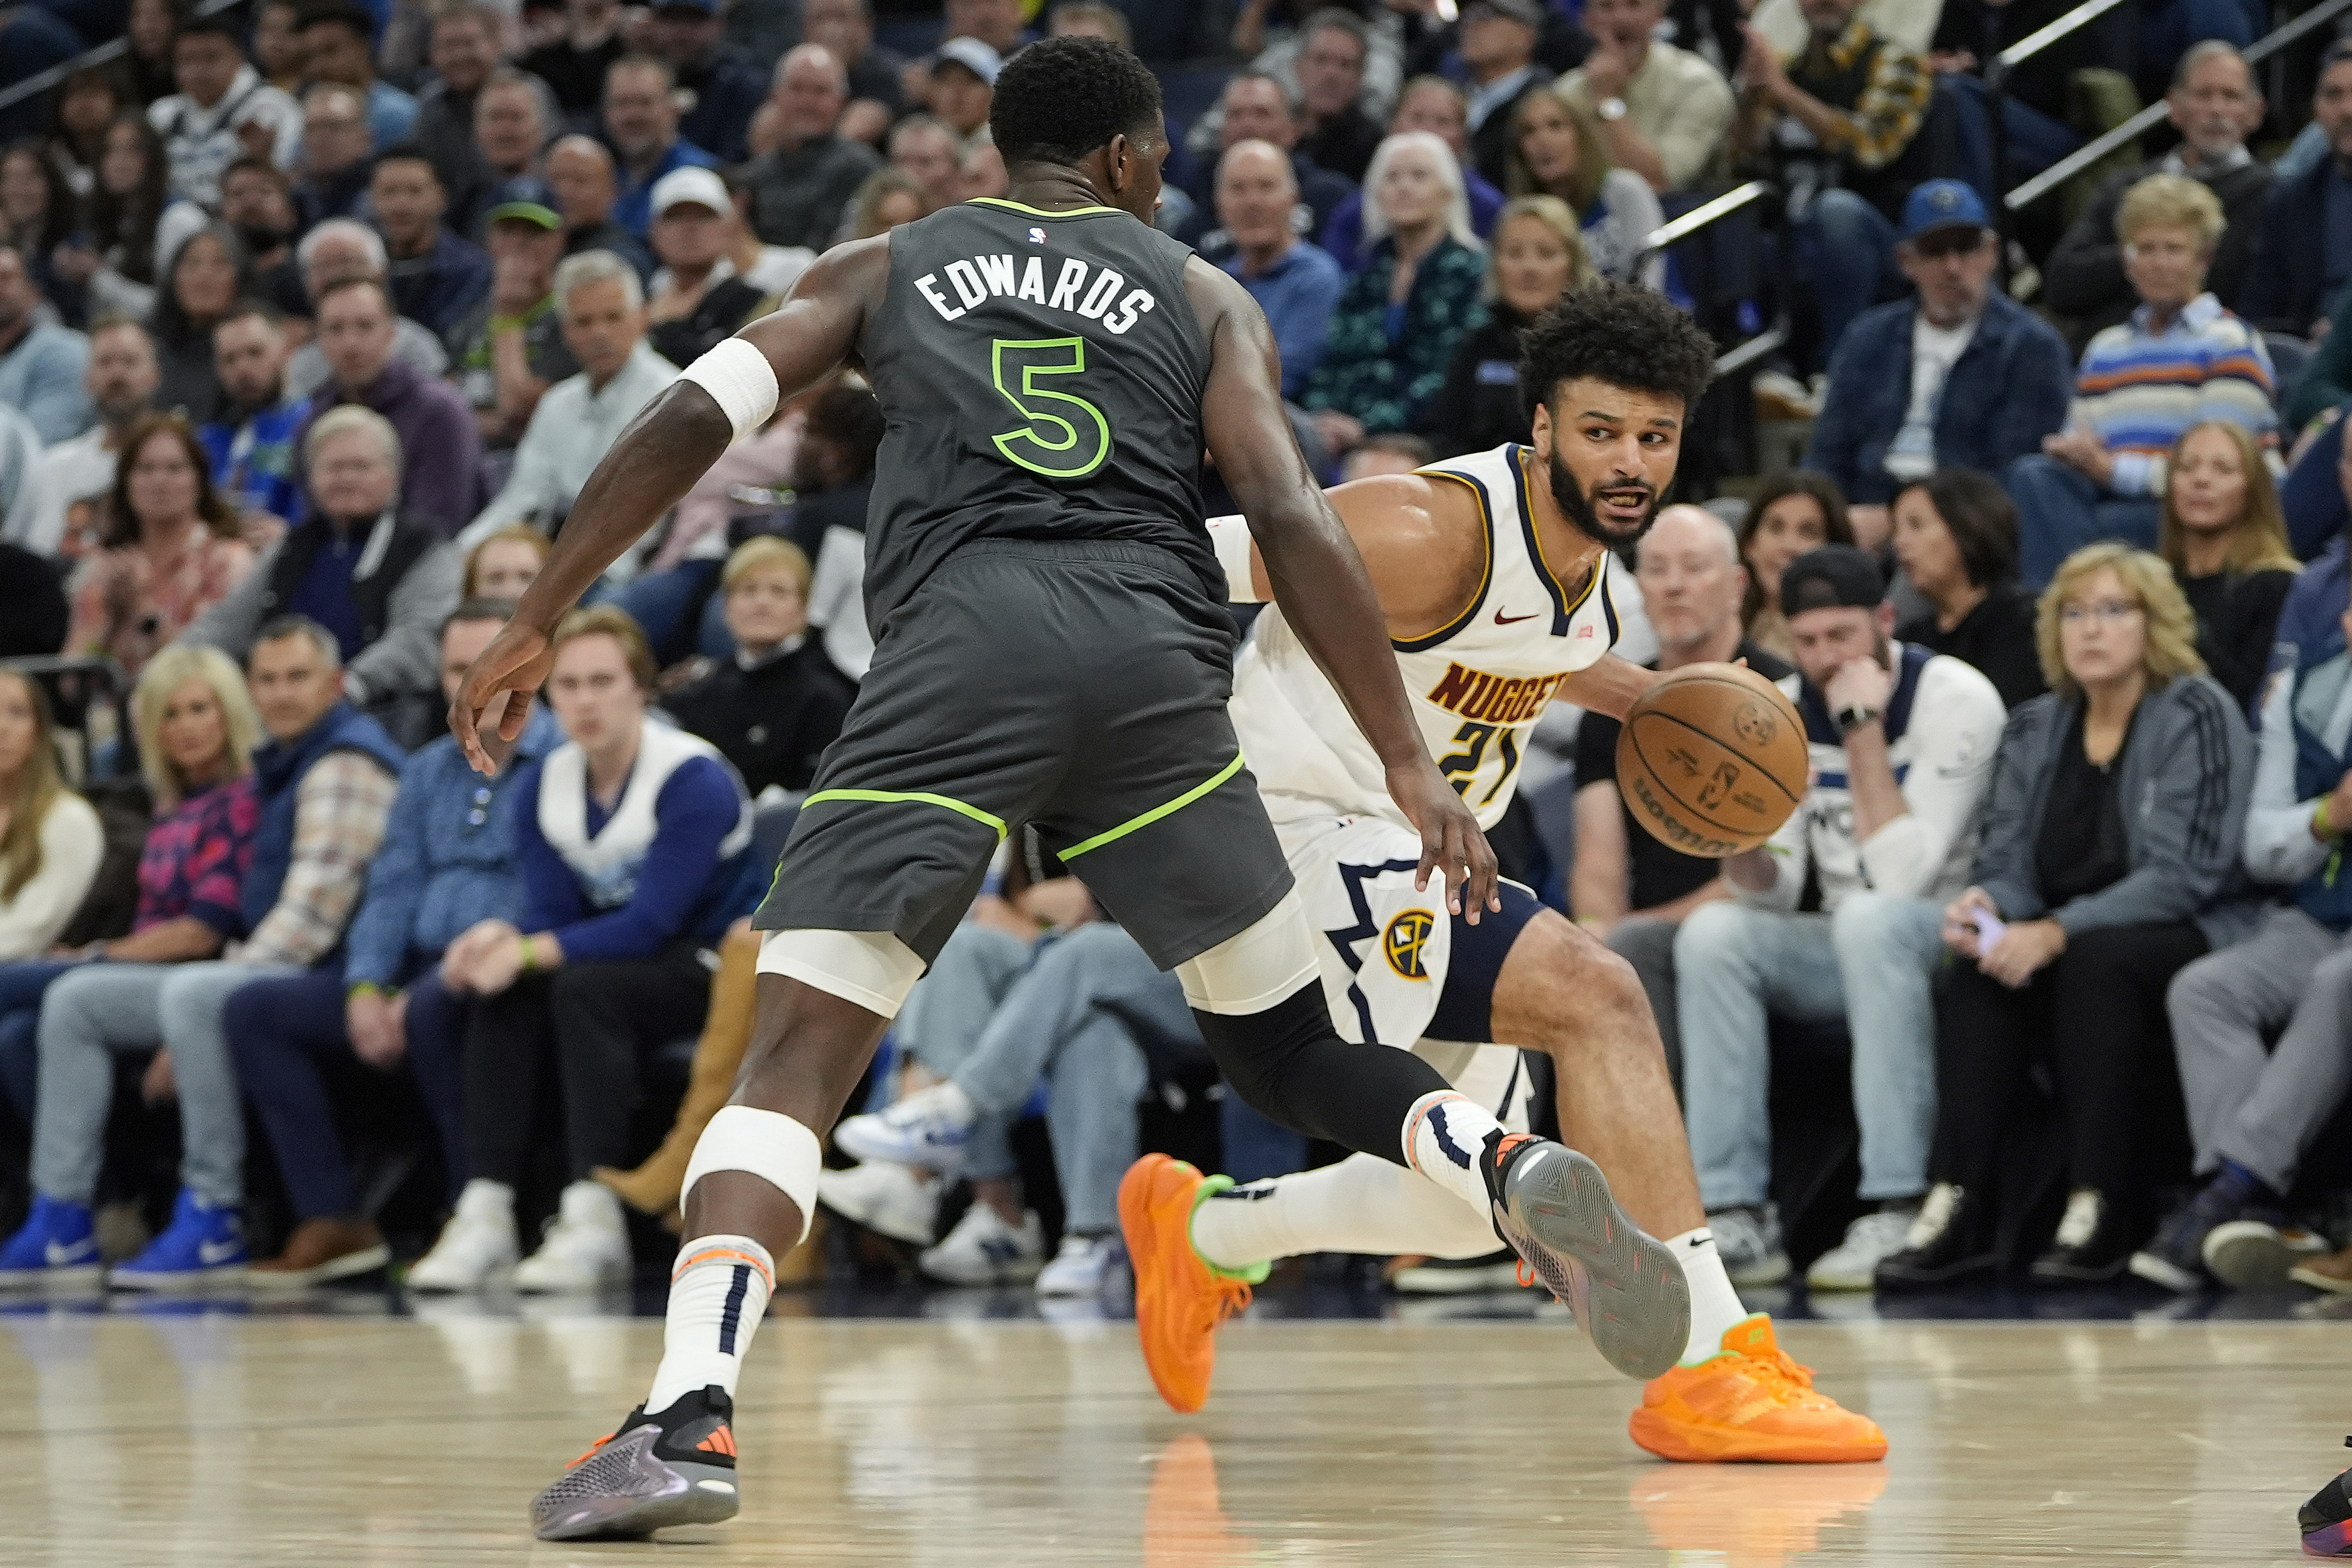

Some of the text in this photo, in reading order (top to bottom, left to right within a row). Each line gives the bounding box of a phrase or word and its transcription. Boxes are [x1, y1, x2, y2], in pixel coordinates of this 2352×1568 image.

[914, 254, 1154, 334] EDWARDS
[992, 336, 1110, 477] 5
[1426, 661, 1570, 725] NUGGE
[1437, 720, 1521, 807] 21
